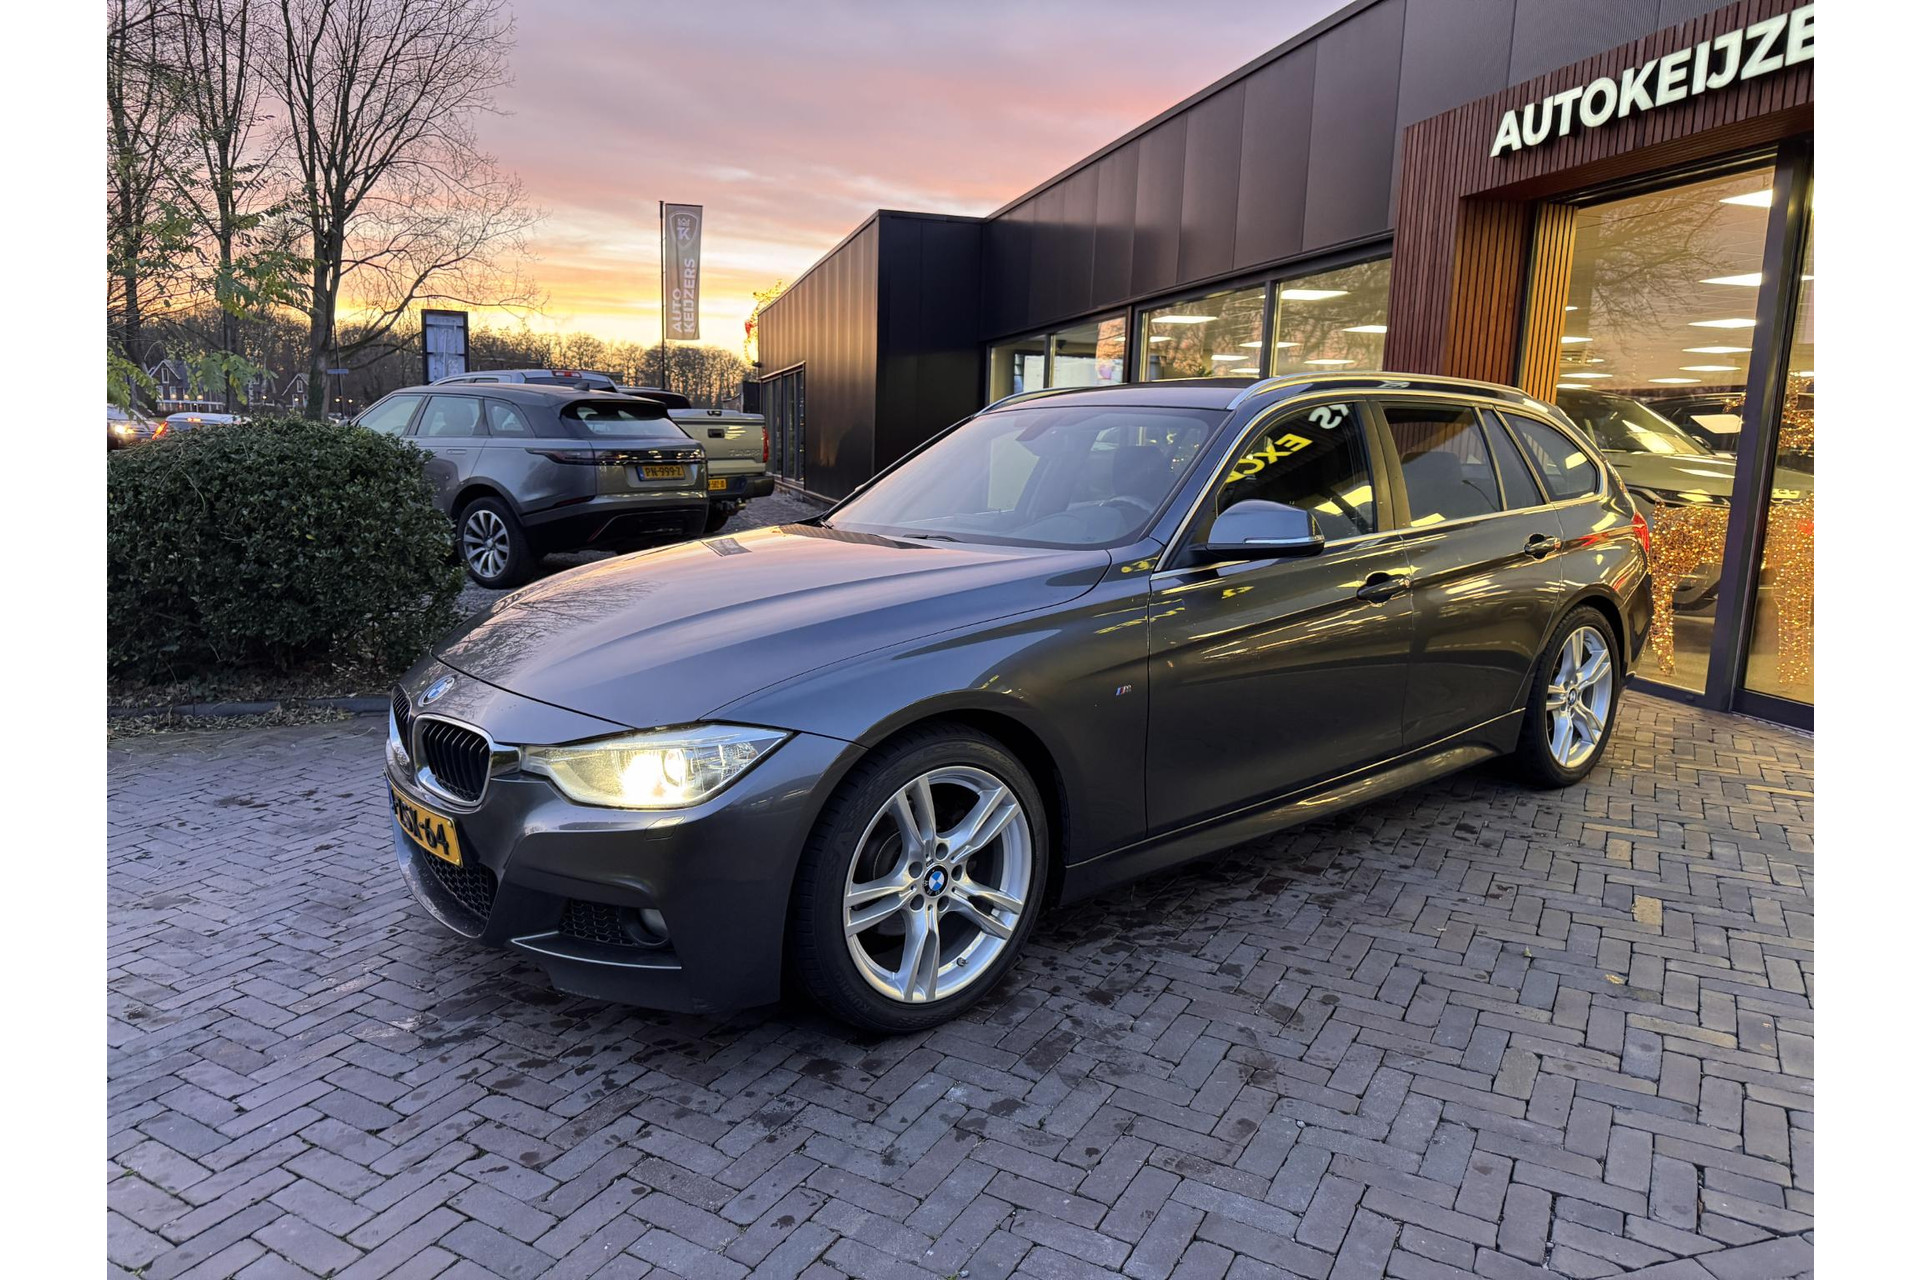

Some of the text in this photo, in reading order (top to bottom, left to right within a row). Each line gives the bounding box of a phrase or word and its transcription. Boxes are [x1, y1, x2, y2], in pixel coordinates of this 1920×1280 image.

[1490, 3, 1814, 158] AUTOKEIJZE
[671, 287, 682, 333] AUTO
[684, 258, 696, 333] KEIJZERS
[644, 465, 682, 477] PN-999-Z
